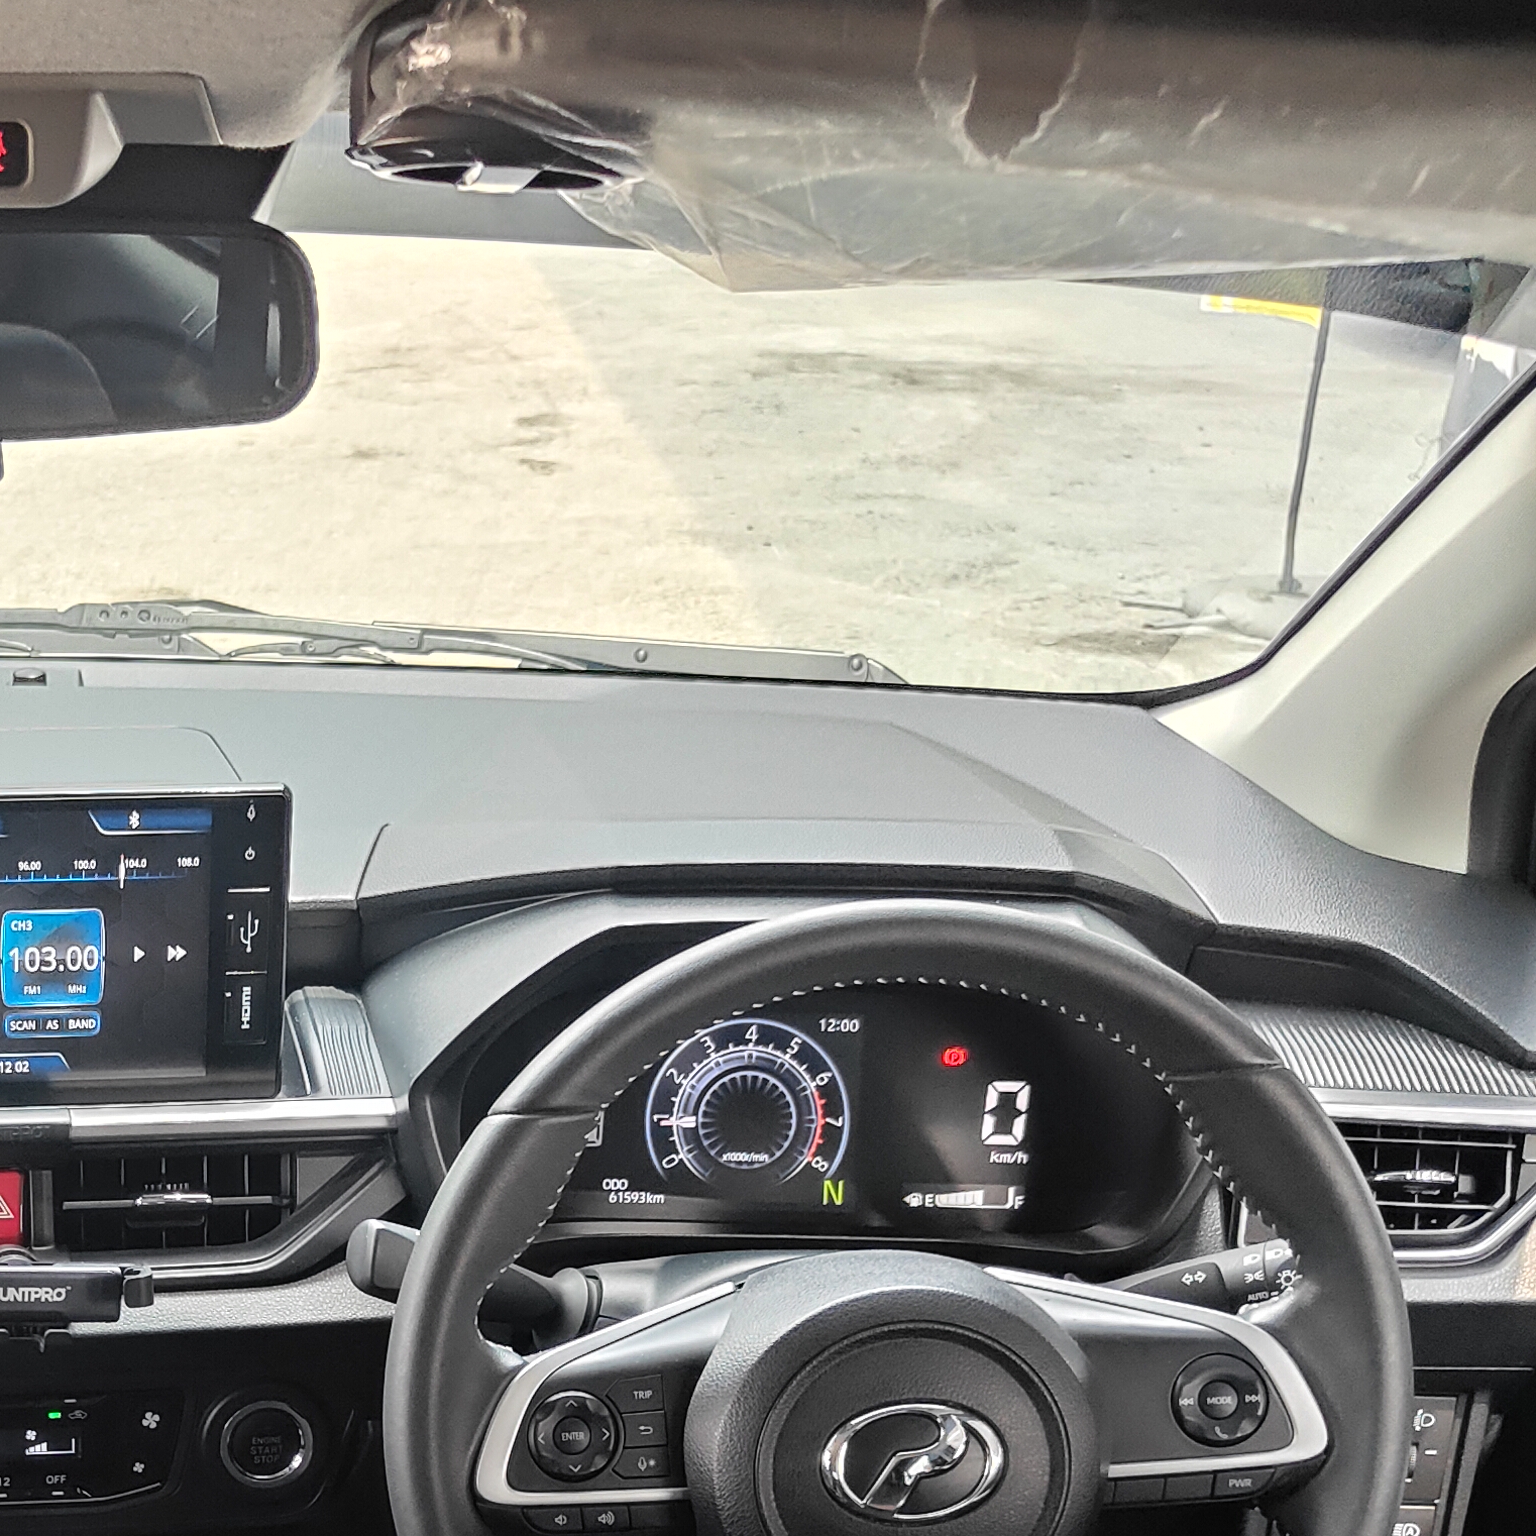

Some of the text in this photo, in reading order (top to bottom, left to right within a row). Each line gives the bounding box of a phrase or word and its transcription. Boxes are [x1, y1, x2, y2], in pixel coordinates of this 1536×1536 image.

[18, 860, 42, 872] 96.00
[73, 859, 97, 871] 100.0
[124, 858, 147, 869] 104.0
[177, 857, 200, 868] 108.0
[10, 920, 33, 931] CH3
[8, 945, 99, 973] 103.00
[23, 985, 41, 995] FM1
[241, 986, 252, 1029] HDMI
[9, 1018, 96, 1031] SCAN AS BAND
[818, 1018, 860, 1033] 12:00
[745, 1025, 759, 1043] 4
[699, 1036, 717, 1054] 3
[785, 1037, 803, 1055] 5
[665, 1068, 685, 1085] 2
[815, 1071, 834, 1086] 6
[981, 1080, 1031, 1146] 0
[825, 1116, 843, 1128] 7
[661, 1155, 680, 1170] 0
[810, 1157, 829, 1173] 8
[989, 1151, 1029, 1165] km/h
[602, 1178, 629, 1190] ODO
[608, 1191, 665, 1204] 61593km
[822, 1179, 845, 1206] N
[925, 1194, 1025, 1210] E F
[1247, 1291, 1269, 1302] AUTO
[633, 1390, 653, 1400] TRIP
[1206, 1395, 1233, 1406] MODE
[561, 1431, 585, 1442] ENTER
[249, 1444, 283, 1455] START
[253, 1454, 281, 1465] STOP
[45, 1474, 67, 1485] OFF
[1228, 1477, 1253, 1488] PWR
